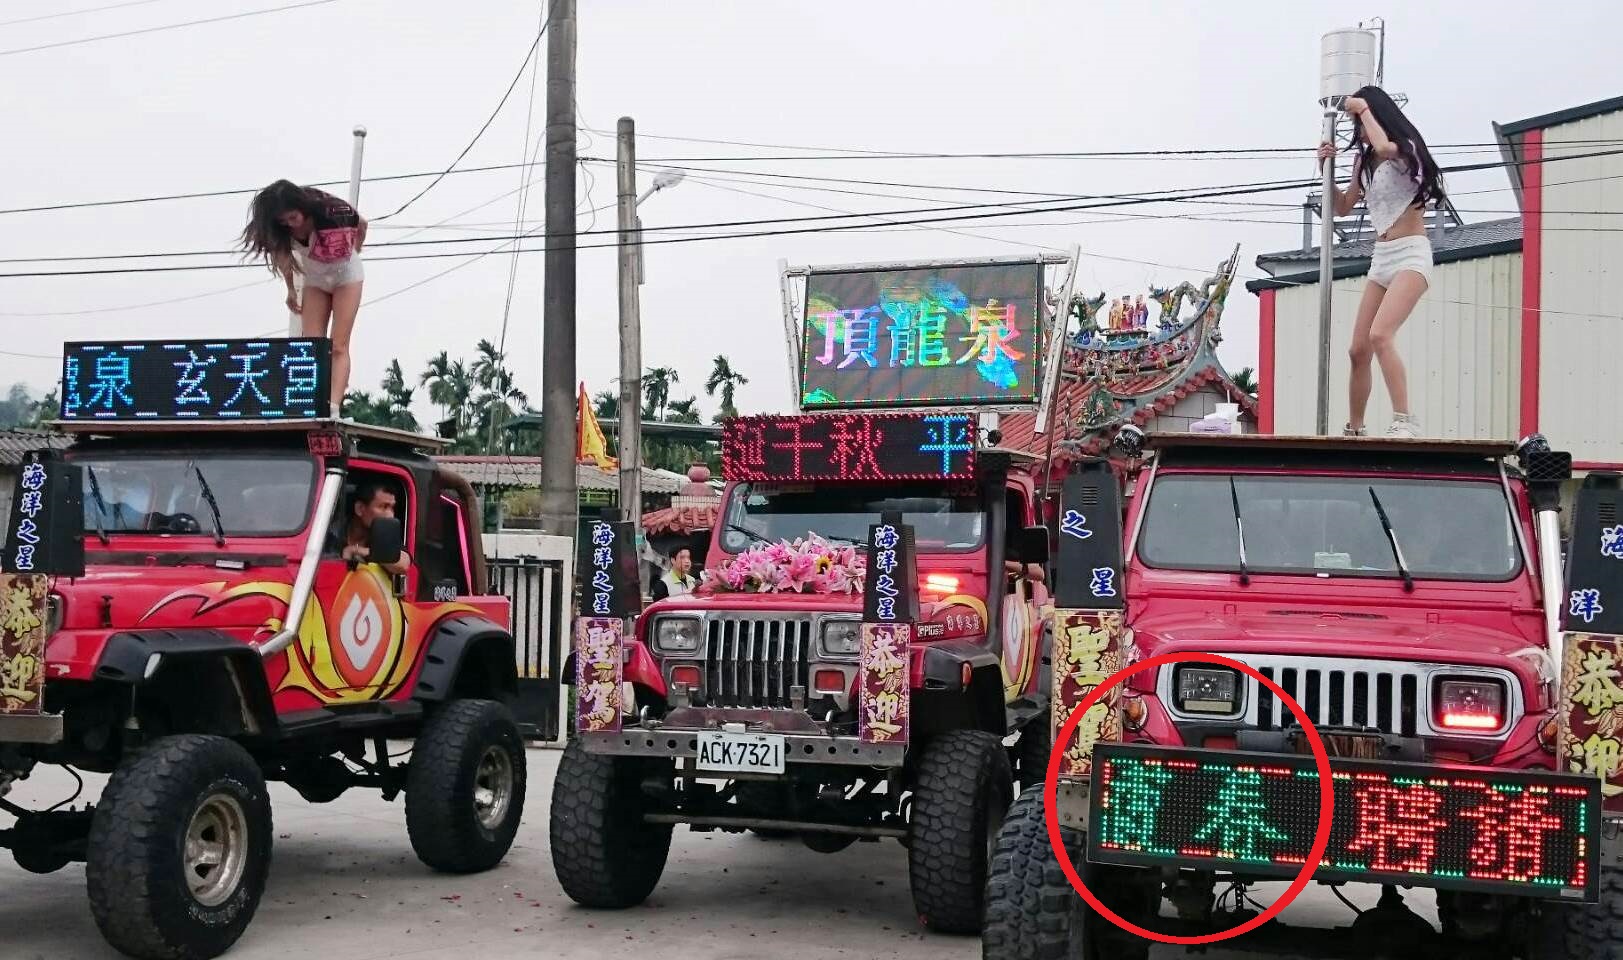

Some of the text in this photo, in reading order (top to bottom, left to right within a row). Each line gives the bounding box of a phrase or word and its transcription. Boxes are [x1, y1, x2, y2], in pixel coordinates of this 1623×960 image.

[173, 347, 317, 407] 玄天宮
[812, 298, 1026, 369] 頂龍泉
[919, 415, 973, 476] 平
[14, 463, 48, 570] 海洋之星
[591, 522, 615, 614] 海洋之星
[874, 524, 901, 619] 海洋之星
[866, 632, 905, 733] 恭迎
[1347, 784, 1561, 876] 聘請
